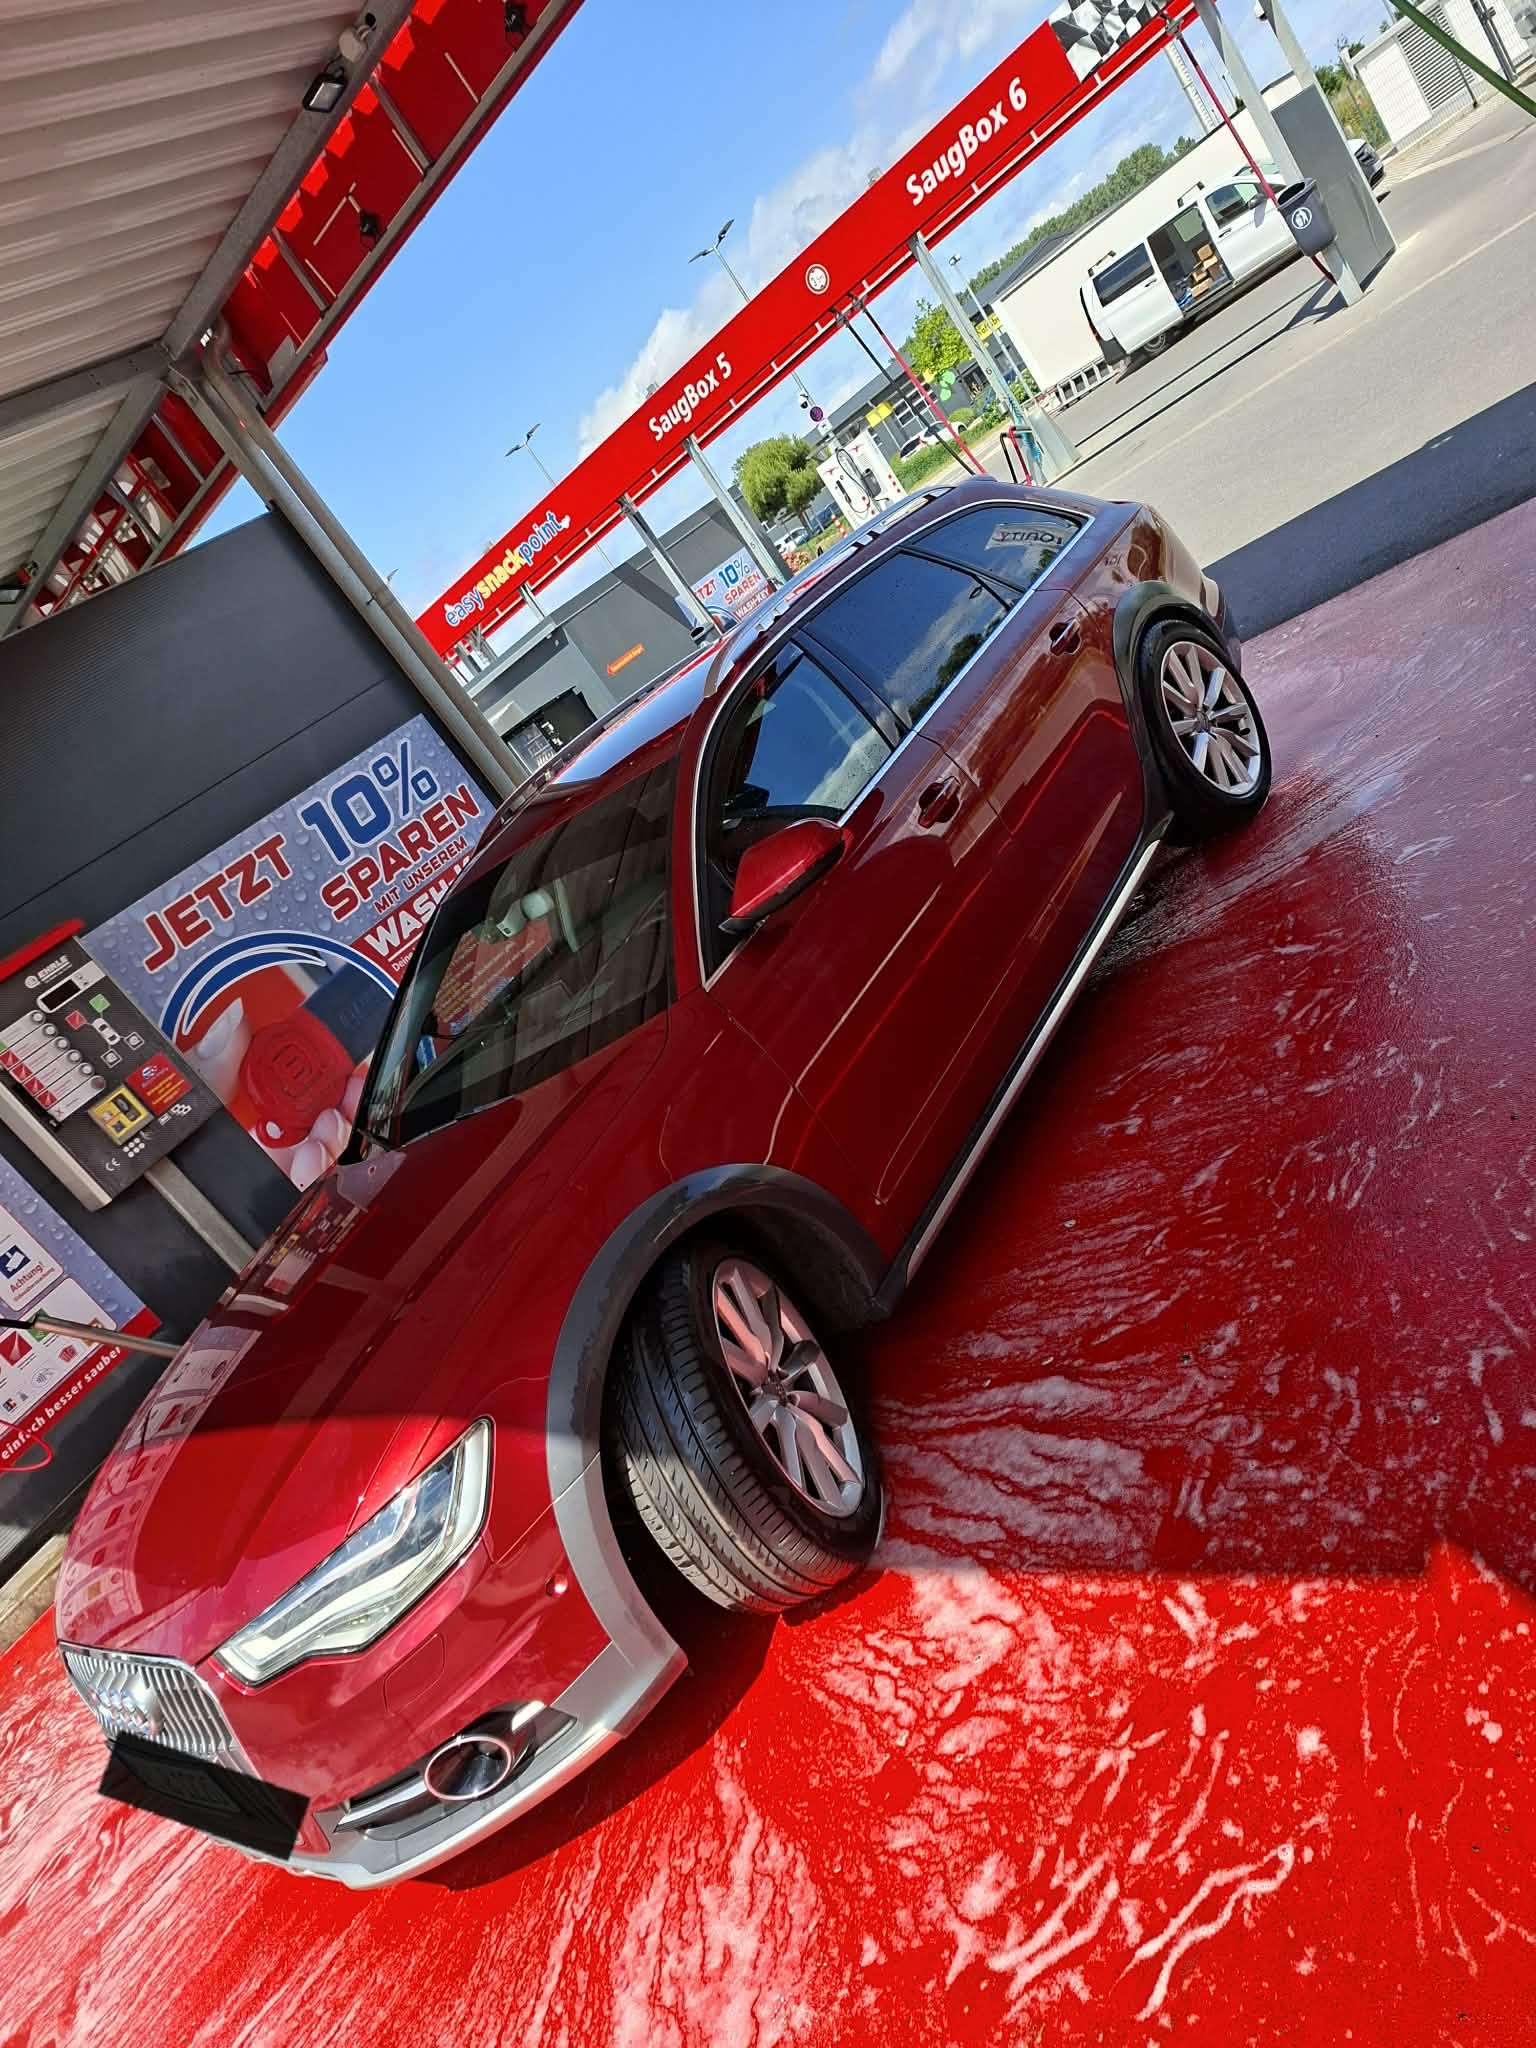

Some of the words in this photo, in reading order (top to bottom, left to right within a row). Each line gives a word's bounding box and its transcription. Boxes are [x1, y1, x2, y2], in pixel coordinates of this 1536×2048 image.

[906, 100, 1009, 206] SaugBox
[1009, 76, 1027, 111] 6
[648, 368, 720, 441] SaugBox
[716, 352, 732, 380] 5
[445, 510, 563, 627] easysnackpoint
[694, 579, 717, 600] TZT
[718, 556, 751, 589] 10%
[724, 570, 762, 605] SPAREN
[144, 832, 292, 975] JETZT
[299, 738, 439, 866] 10%
[320, 782, 481, 922] SPAREN
[374, 886, 400, 914] MIT
[402, 836, 468, 891] UNSEREM
[10, 1260, 46, 1292] Achtung!
[44, 1380, 83, 1419] besser
